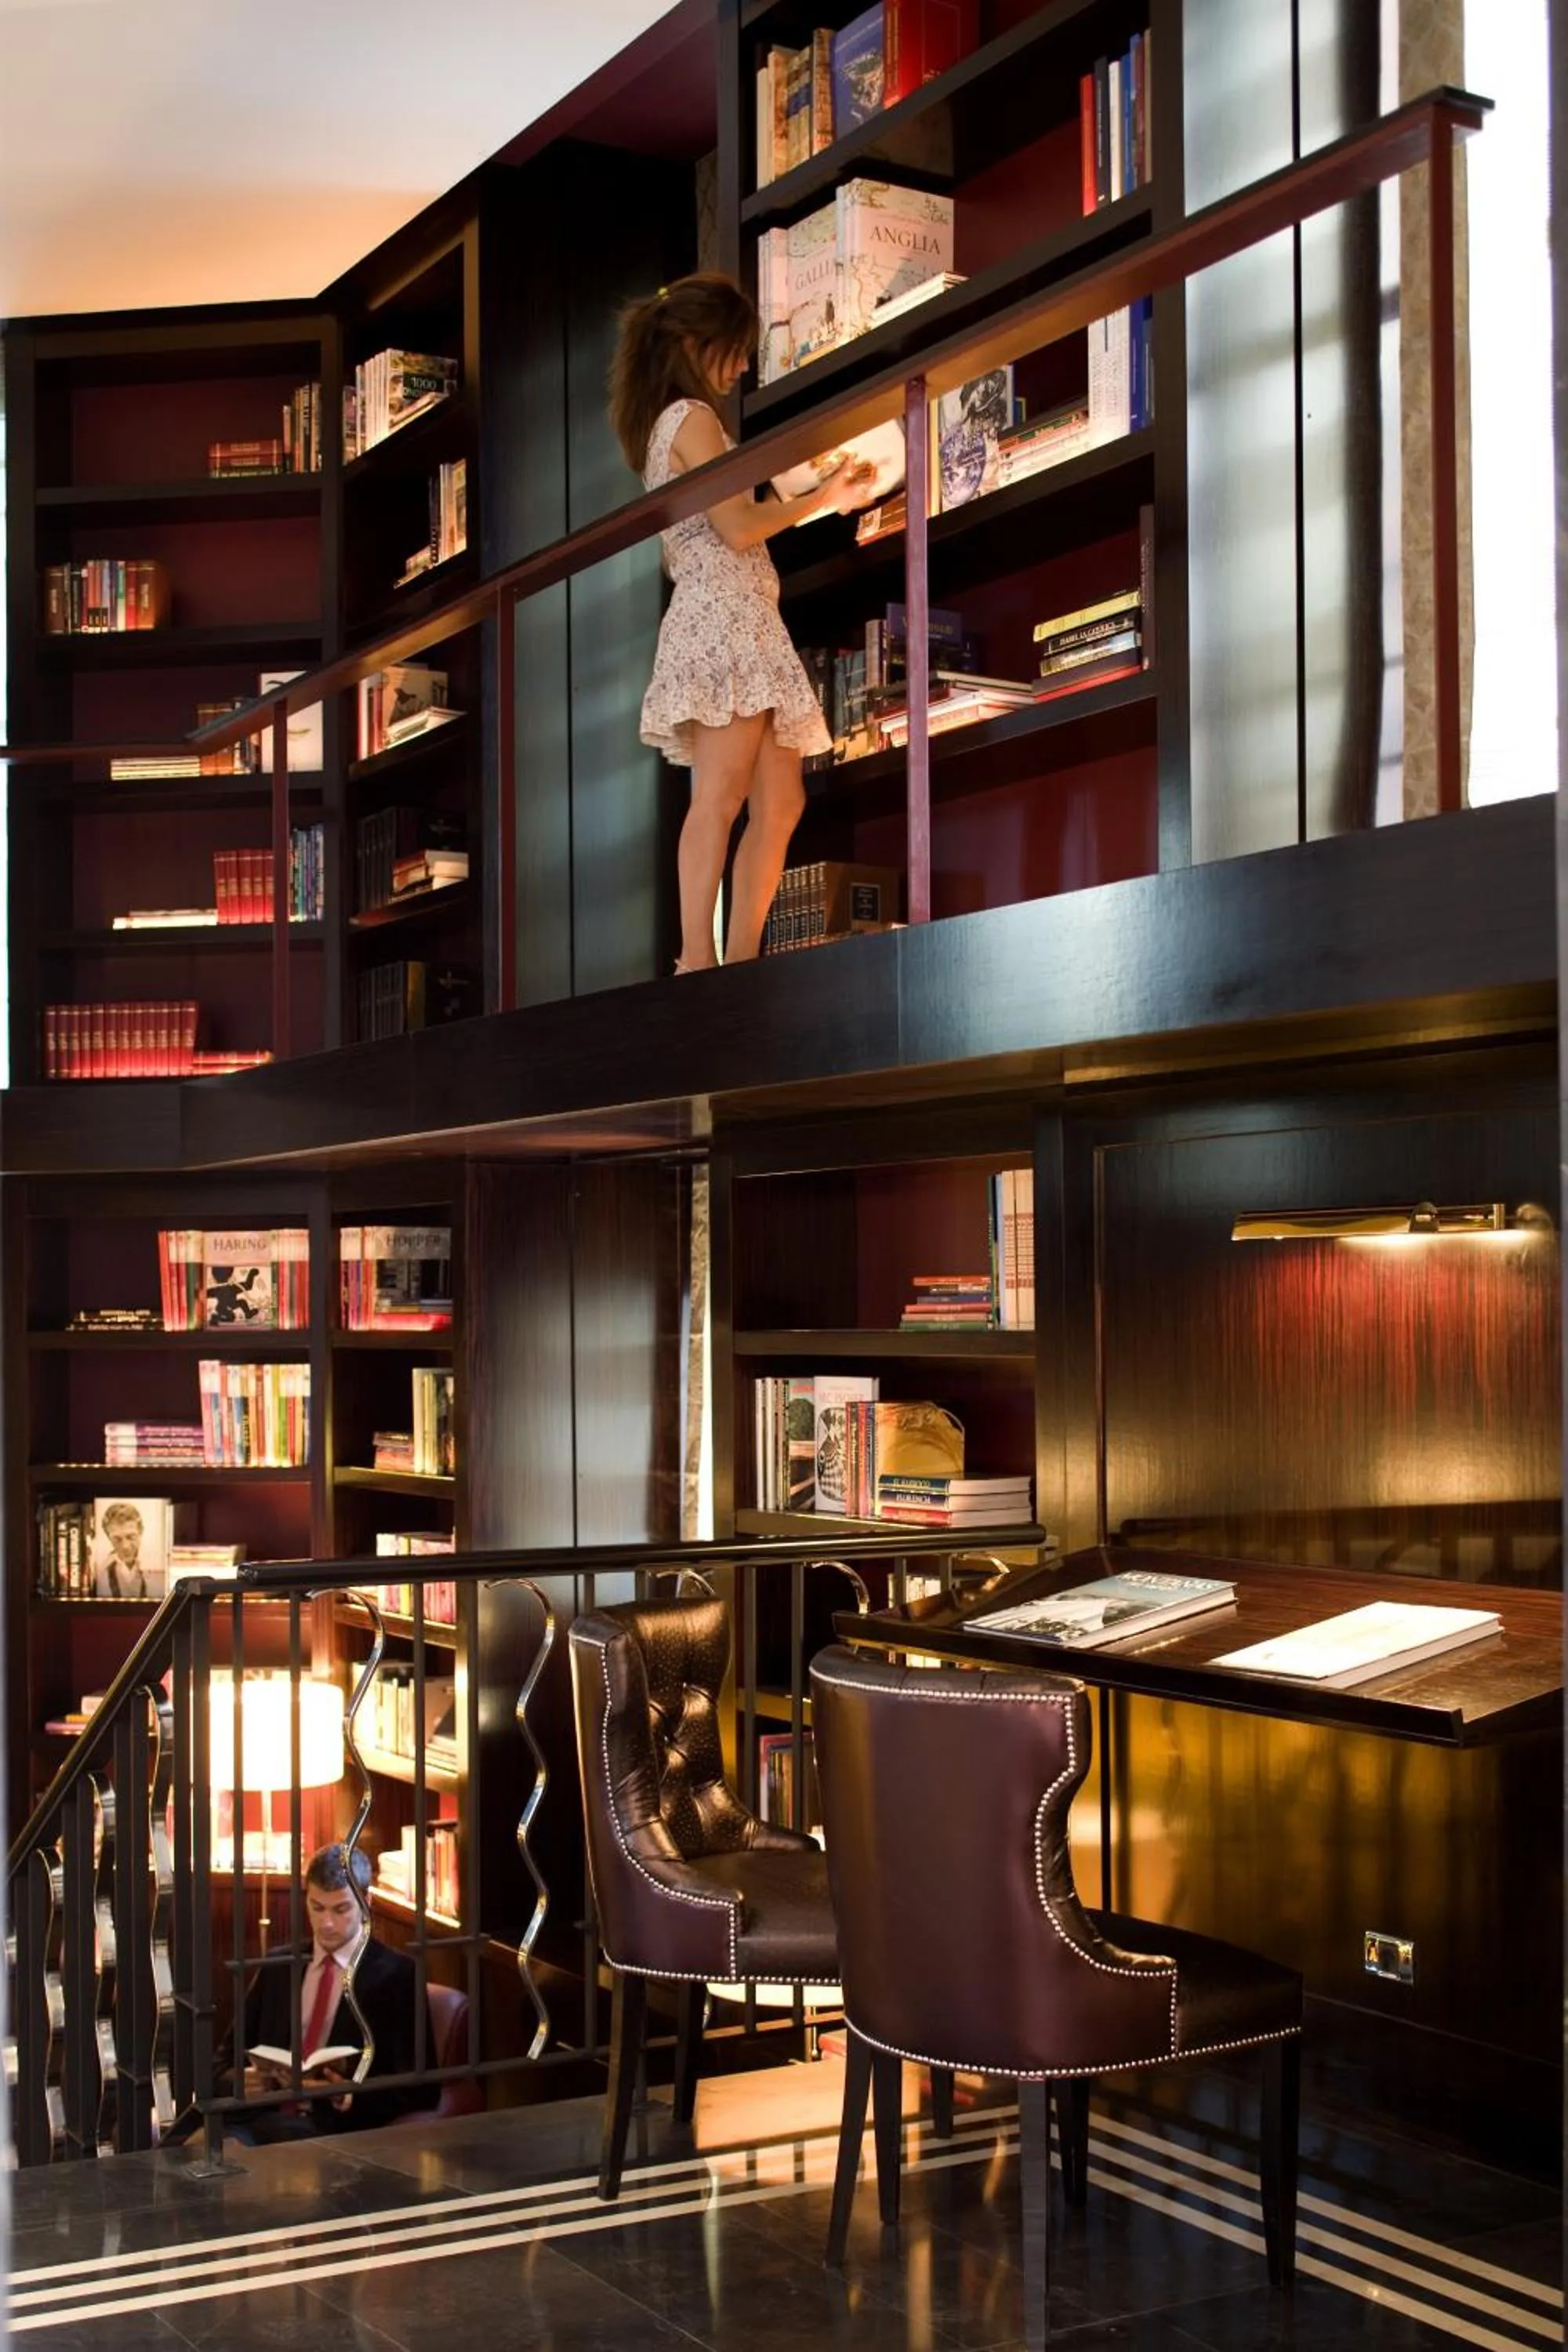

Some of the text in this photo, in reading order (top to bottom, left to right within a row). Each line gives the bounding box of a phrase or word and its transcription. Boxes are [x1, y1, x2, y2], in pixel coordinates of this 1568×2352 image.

[869, 224, 941, 255] ANGLIA
[213, 1238, 267, 1251] HARING
[387, 1233, 441, 1247] HOPPER
